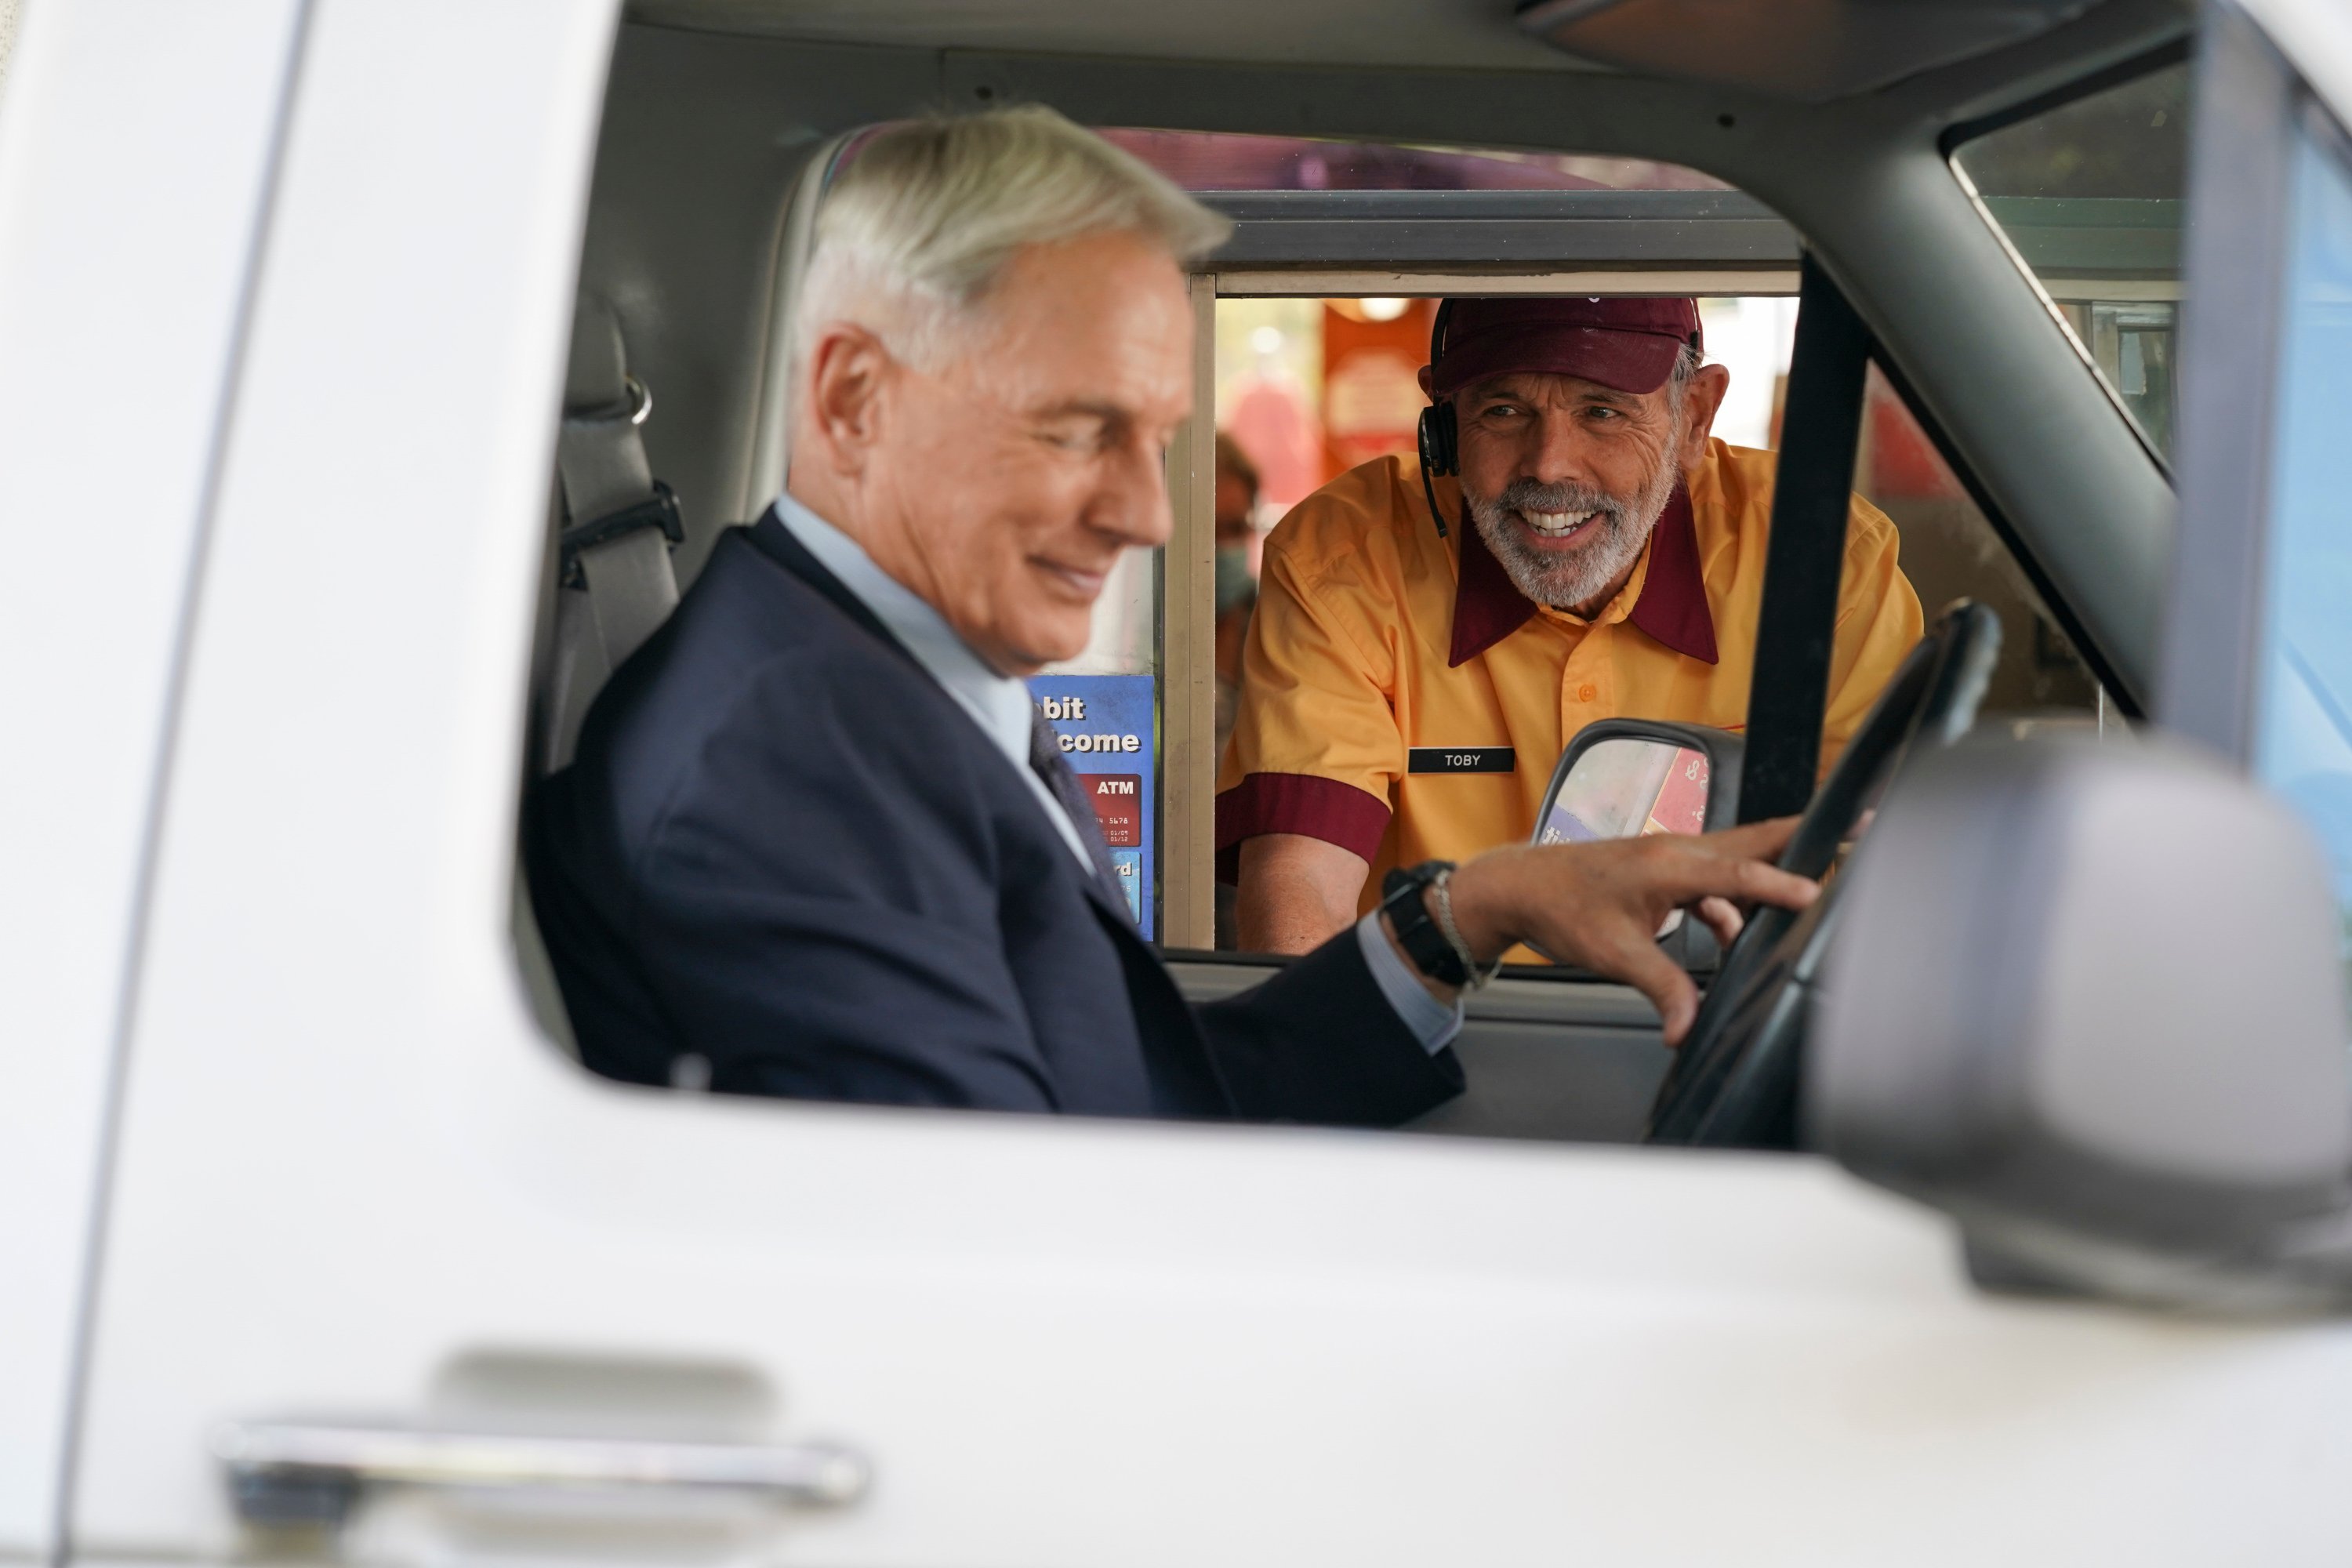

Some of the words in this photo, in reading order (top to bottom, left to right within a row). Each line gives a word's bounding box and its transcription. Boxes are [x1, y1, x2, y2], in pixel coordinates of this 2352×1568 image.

[1037, 695, 1085, 720] bit
[1053, 731, 1141, 753] come
[1445, 754, 1481, 766] TOBY
[1097, 782, 1134, 794] ATM
